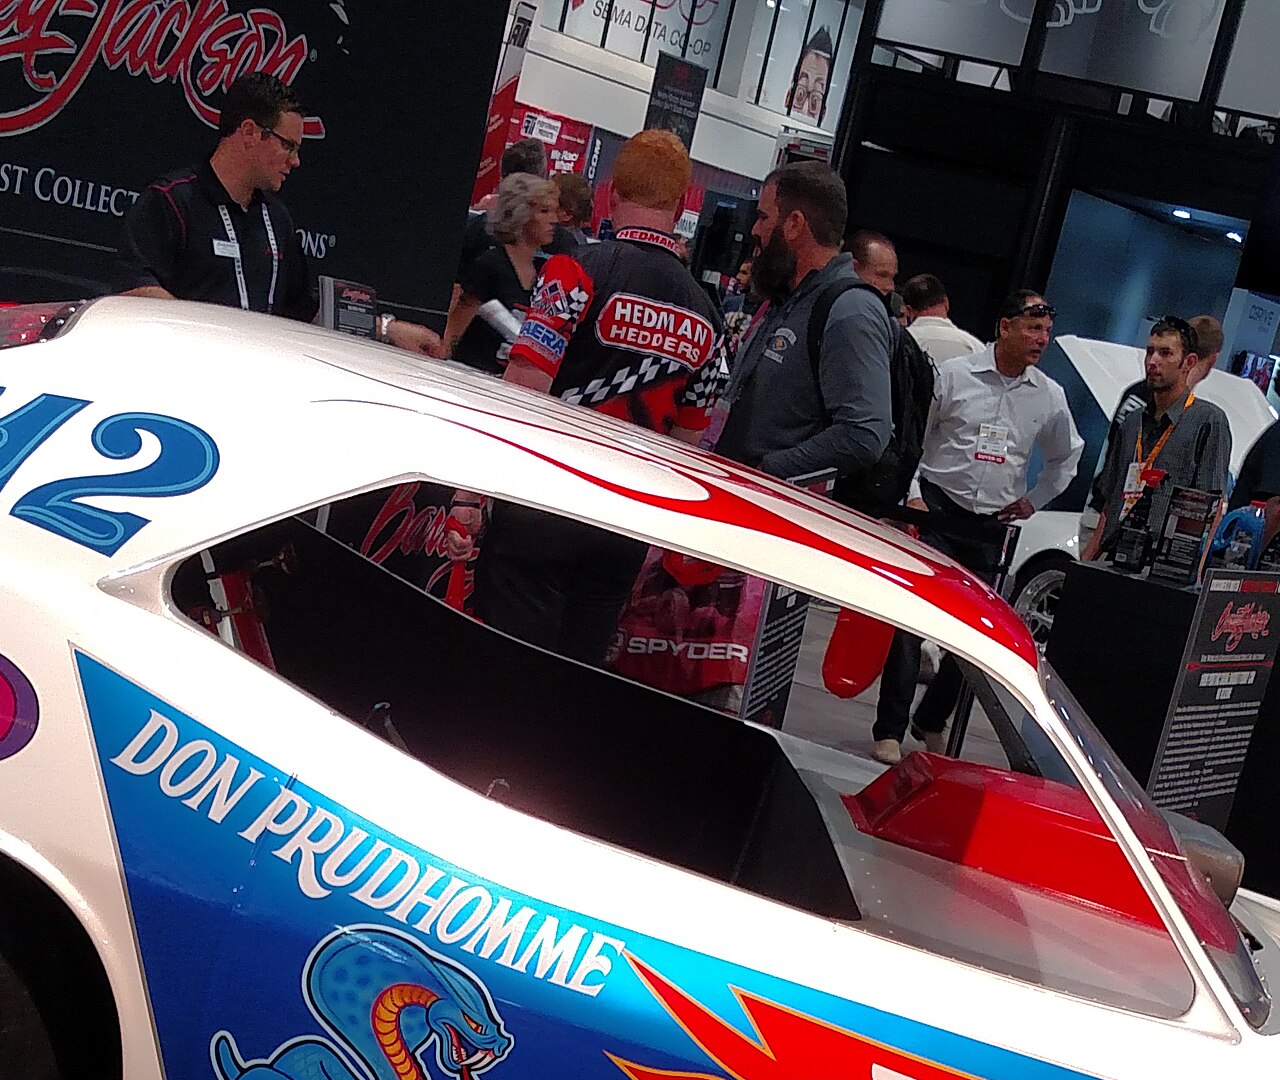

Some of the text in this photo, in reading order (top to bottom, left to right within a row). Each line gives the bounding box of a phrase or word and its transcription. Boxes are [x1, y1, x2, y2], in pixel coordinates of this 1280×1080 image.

[593, 0, 632, 28] SEMA
[635, 16, 667, 41] DATA
[520, 320, 568, 355] AERA
[609, 325, 701, 363] HEDDERS
[614, 302, 708, 347] HEDMAN
[627, 636, 749, 663] SPYDER
[108, 709, 626, 997] DON PRUDHOMME
